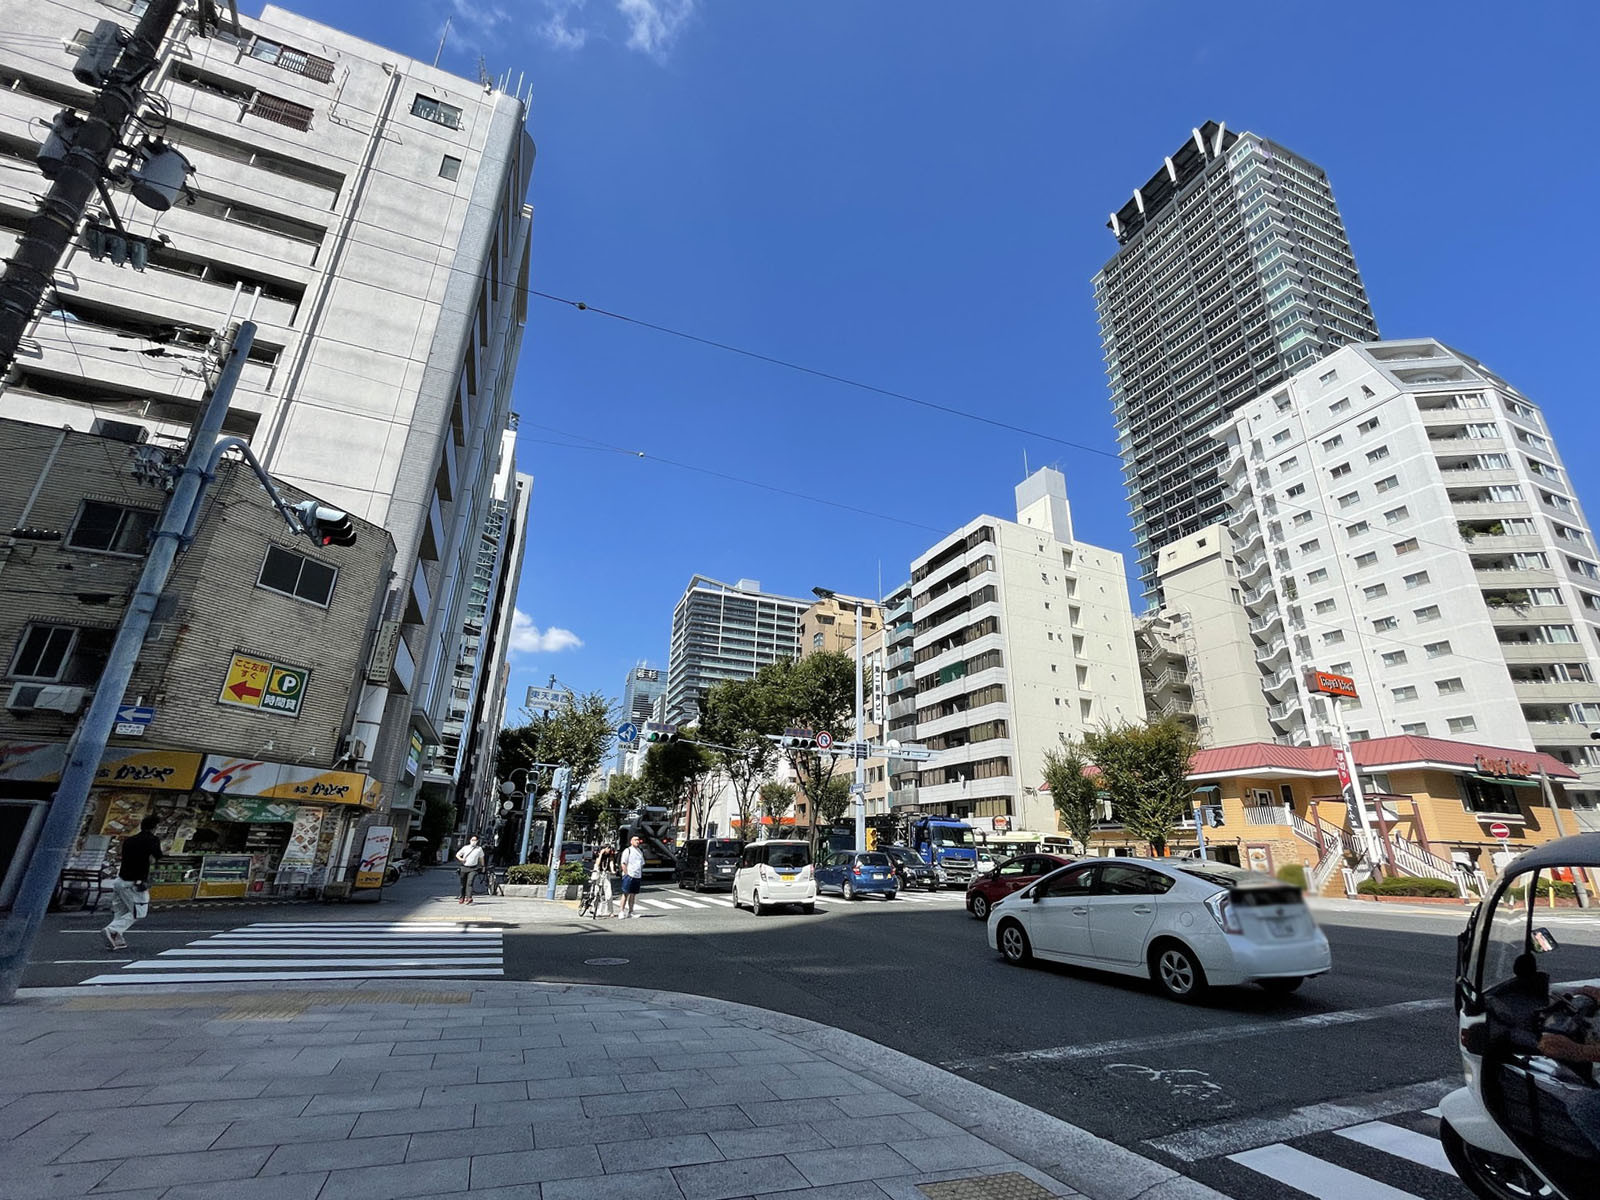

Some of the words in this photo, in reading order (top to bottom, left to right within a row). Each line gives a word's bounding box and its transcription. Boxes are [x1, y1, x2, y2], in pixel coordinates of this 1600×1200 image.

[282, 676, 297, 692] P
[263, 694, 297, 711] 時間貸
